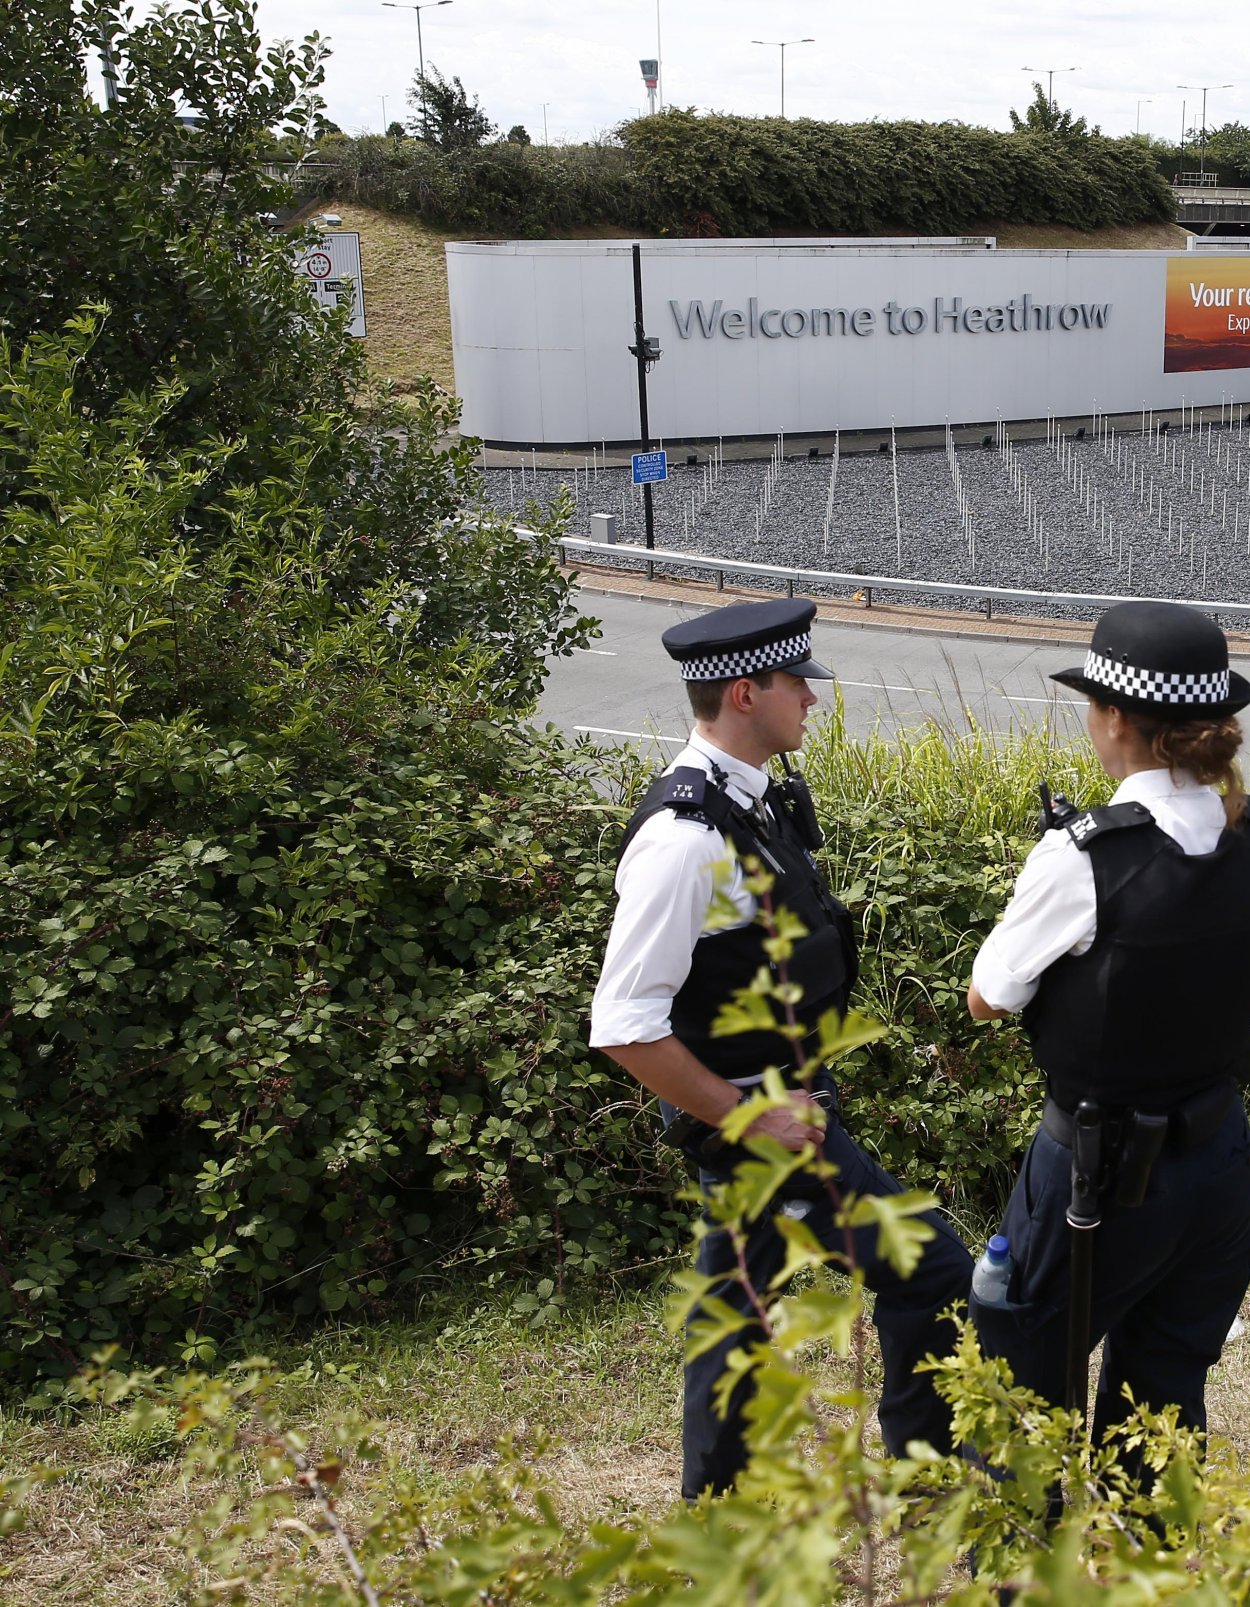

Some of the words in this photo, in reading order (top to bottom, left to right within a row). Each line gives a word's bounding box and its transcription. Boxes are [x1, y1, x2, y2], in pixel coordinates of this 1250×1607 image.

[1189, 282, 1234, 308] Your
[669, 297, 876, 339] Welcome
[883, 300, 928, 336] to
[934, 293, 1112, 334] Heathrow
[638, 454, 661, 463] POLICE
[672, 790, 693, 798] 148
